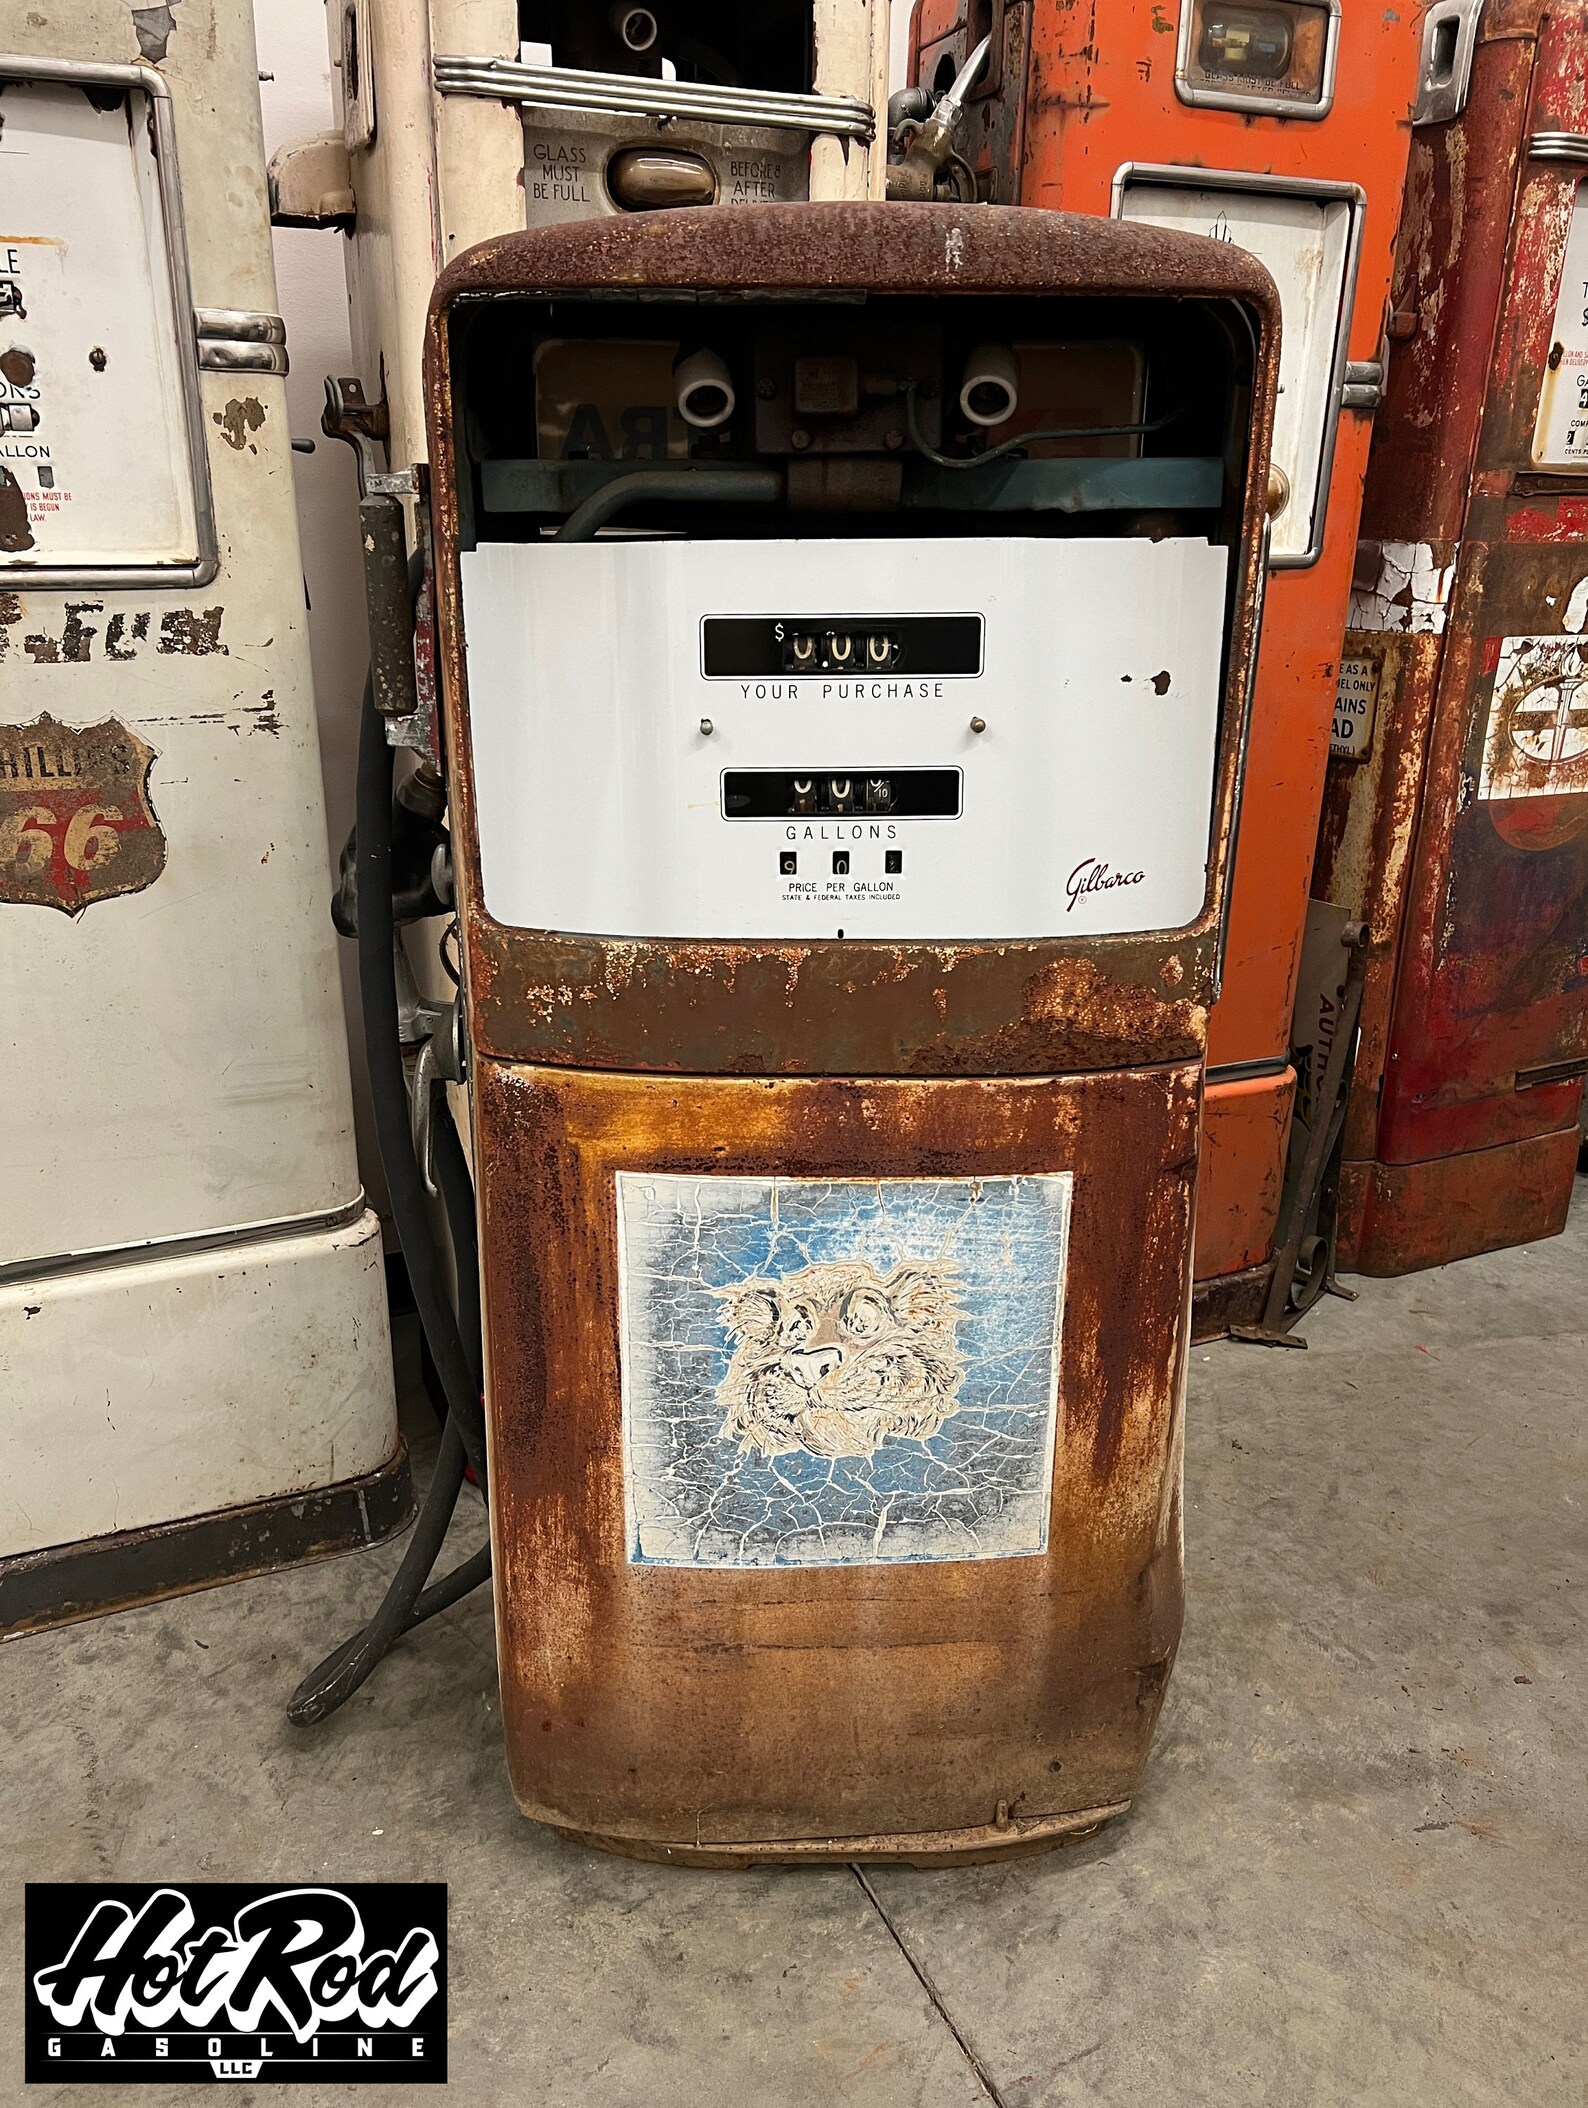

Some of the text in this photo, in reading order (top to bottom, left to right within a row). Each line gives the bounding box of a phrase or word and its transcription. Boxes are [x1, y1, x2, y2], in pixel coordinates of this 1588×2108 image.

[533, 144, 586, 163] GLASS
[543, 164, 580, 182] MUST
[730, 161, 773, 179] BEFORE
[533, 183, 591, 202] BE FULL
[733, 180, 775, 198] AFTER
[42, 492, 62, 501] MUST
[64, 493, 73, 501] BE
[30, 503, 60, 511] IS BEGUN
[1346, 664, 1359, 675] AS
[1361, 665, 1368, 676] A
[741, 683, 944, 699] YOUR PURCHASE
[1353, 680, 1376, 692] ONLY
[0, 805, 124, 871] 66
[785, 825, 897, 840] GALLONS
[788, 882, 894, 893] PRICE PER GALLON
[1066, 857, 1146, 912] Gilbarco
